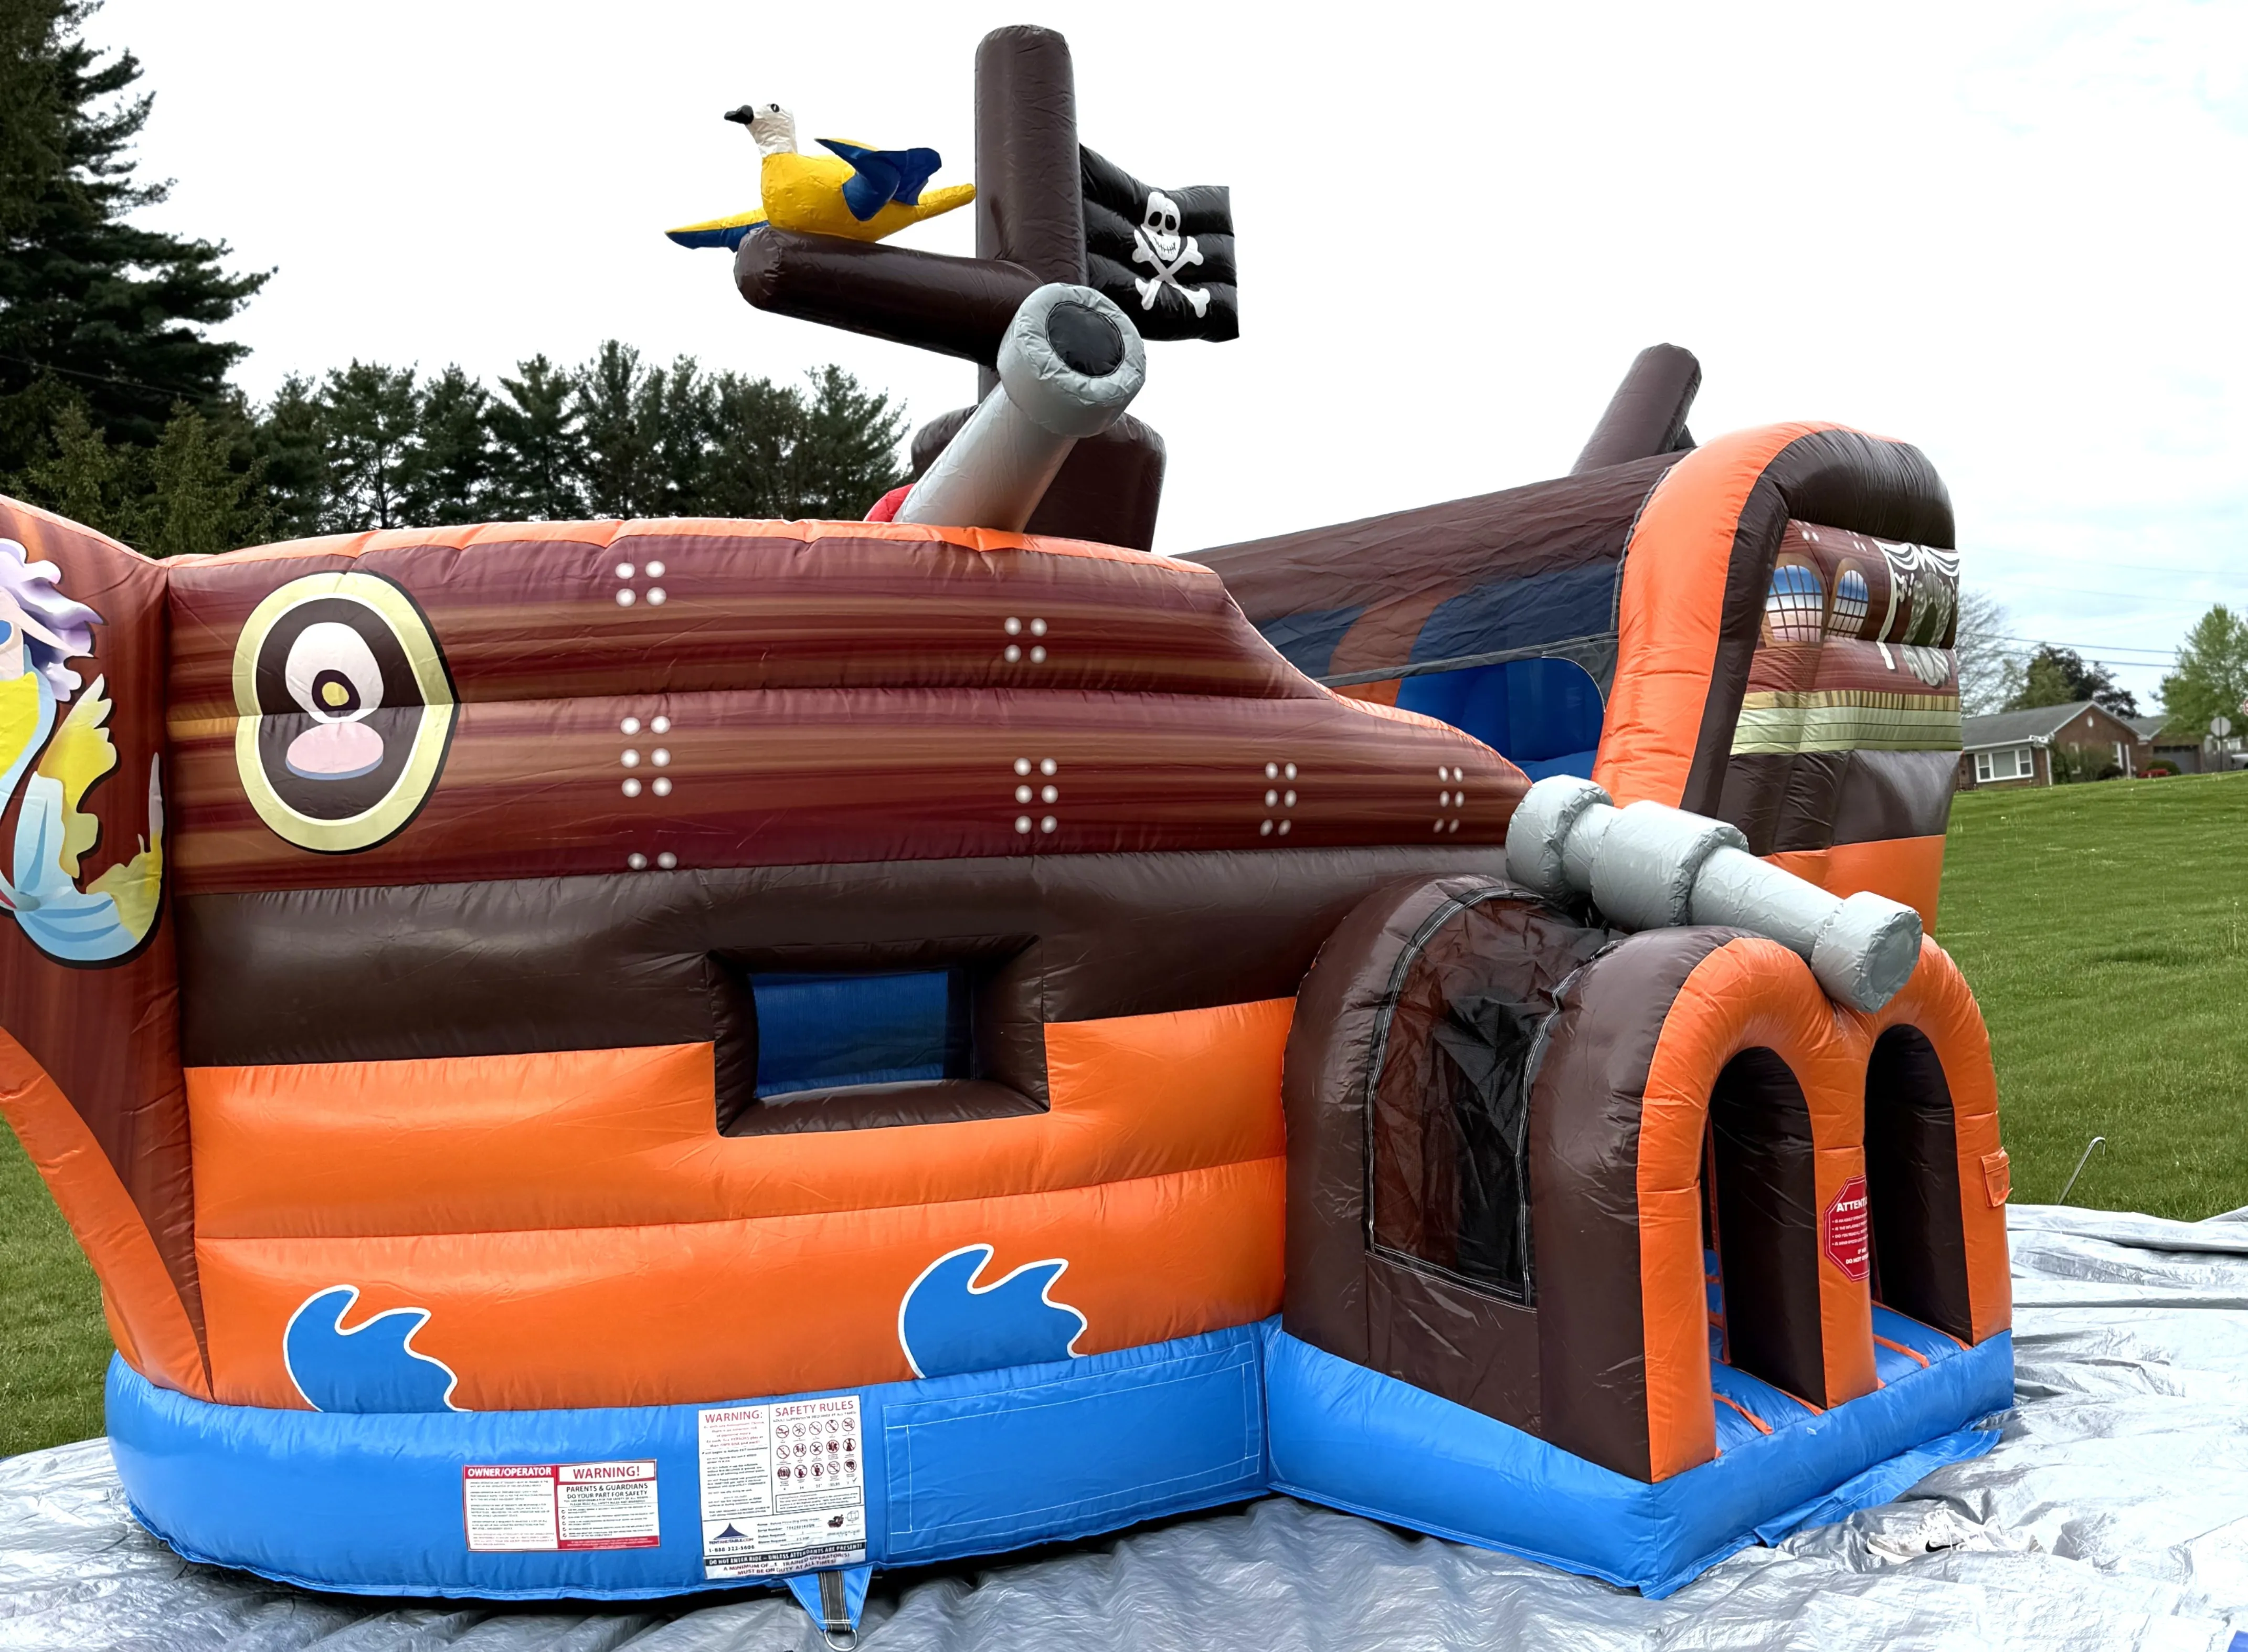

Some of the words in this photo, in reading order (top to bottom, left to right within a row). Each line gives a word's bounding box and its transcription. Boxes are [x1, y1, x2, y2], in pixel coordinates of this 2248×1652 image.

[776, 1404, 816, 1417] SAFETY
[820, 1401, 854, 1412] RULES
[705, 1410, 762, 1423] WARNING:
[468, 1467, 552, 1477] OWNER/OPERATOR
[573, 1466, 640, 1479] WARNING!
